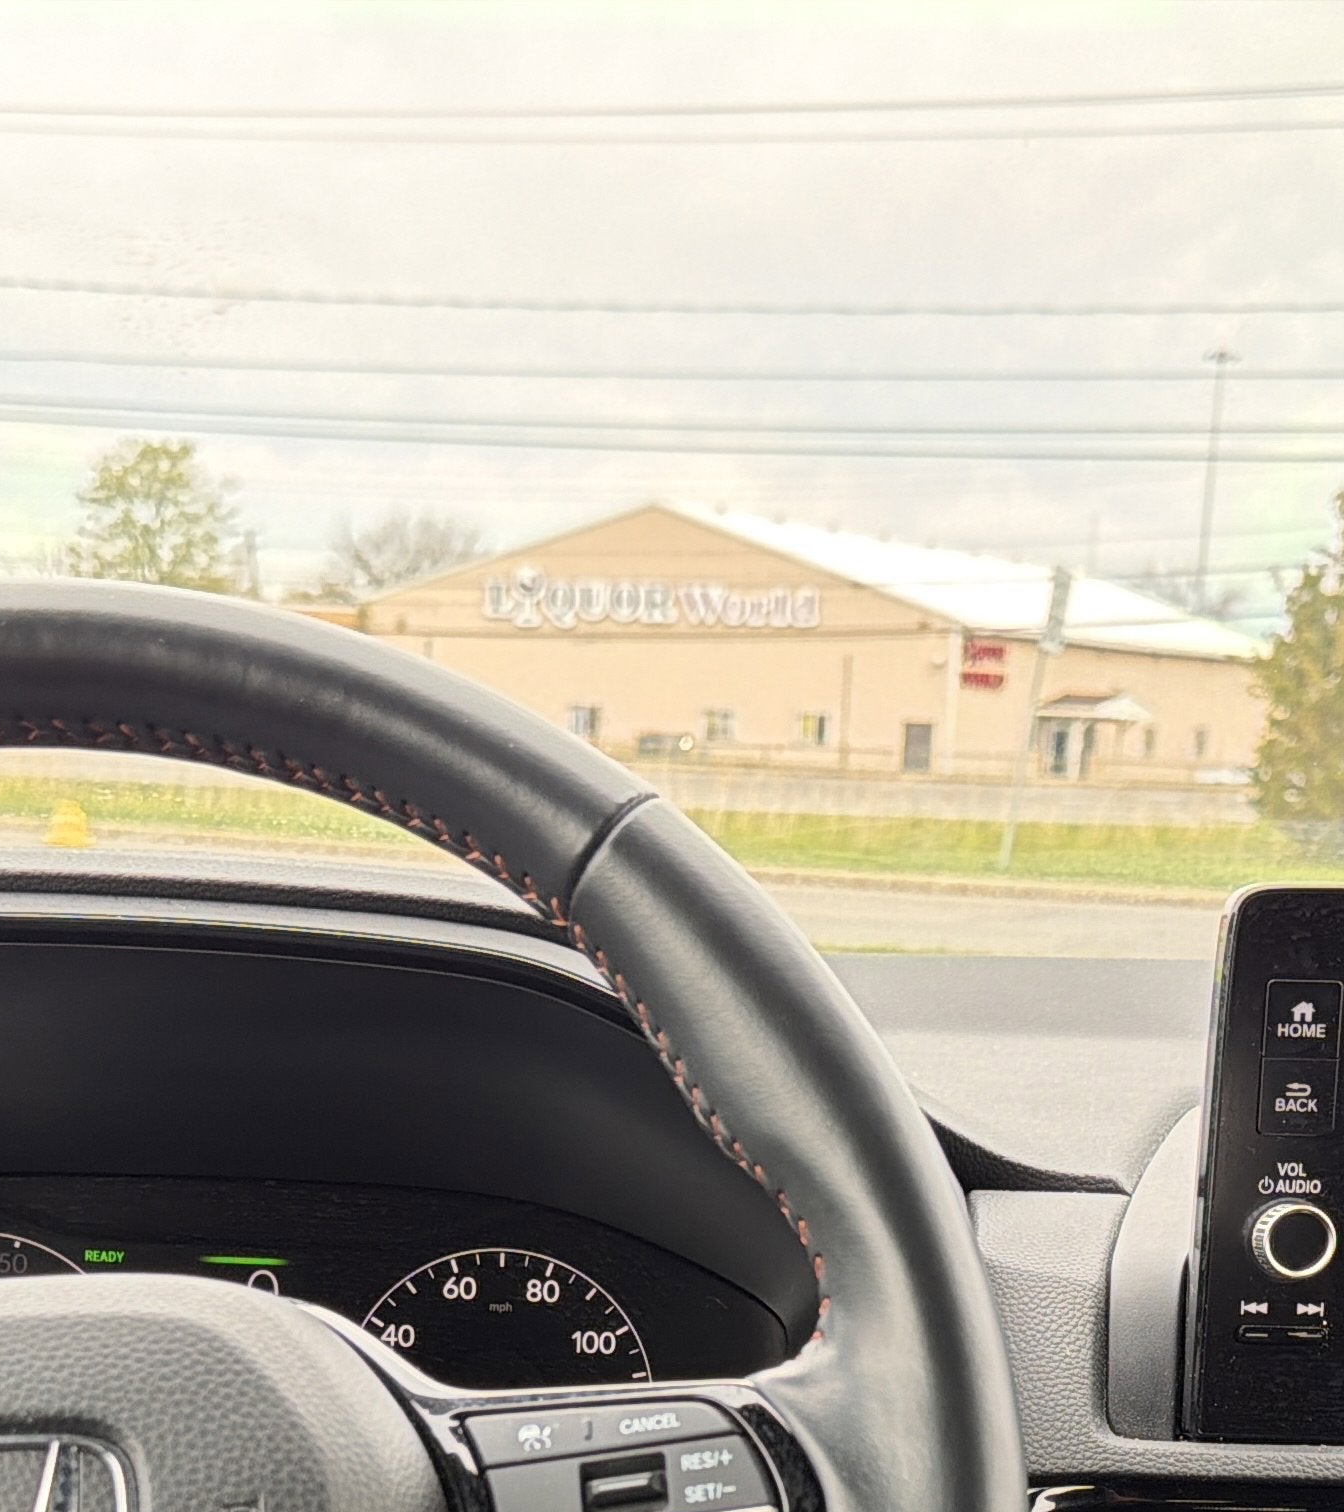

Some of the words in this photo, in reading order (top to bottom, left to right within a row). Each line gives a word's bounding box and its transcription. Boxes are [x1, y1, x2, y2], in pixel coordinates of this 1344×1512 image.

[1277, 1023, 1326, 1038] HOME
[1275, 1098, 1318, 1113] BACK
[1277, 1162, 1306, 1177] VOL
[1275, 1179, 1322, 1194] AUDIO
[84, 1250, 125, 1264] READY
[442, 1276, 477, 1301] 60
[525, 1279, 560, 1304] 80
[489, 1302, 513, 1313] mph
[380, 1323, 415, 1348] 40
[570, 1330, 616, 1356] 100
[619, 1413, 681, 1435] CANCEL
